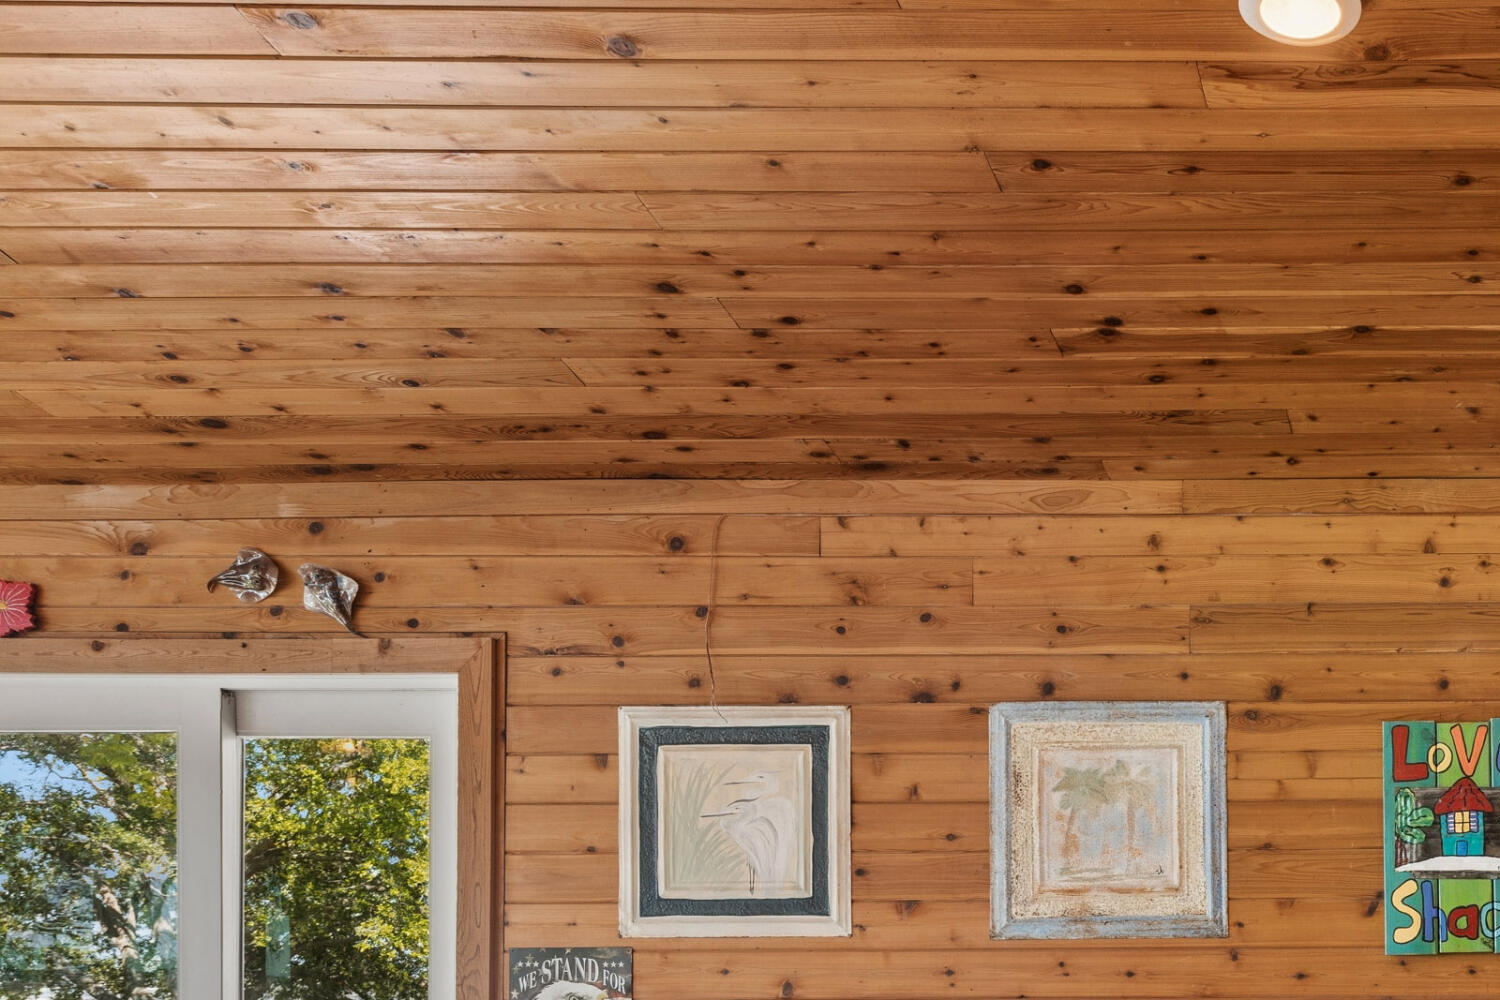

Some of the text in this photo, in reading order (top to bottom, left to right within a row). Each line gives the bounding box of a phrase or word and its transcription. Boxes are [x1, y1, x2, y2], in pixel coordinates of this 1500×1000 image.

[518, 957, 626, 994] WE STAND FOR
